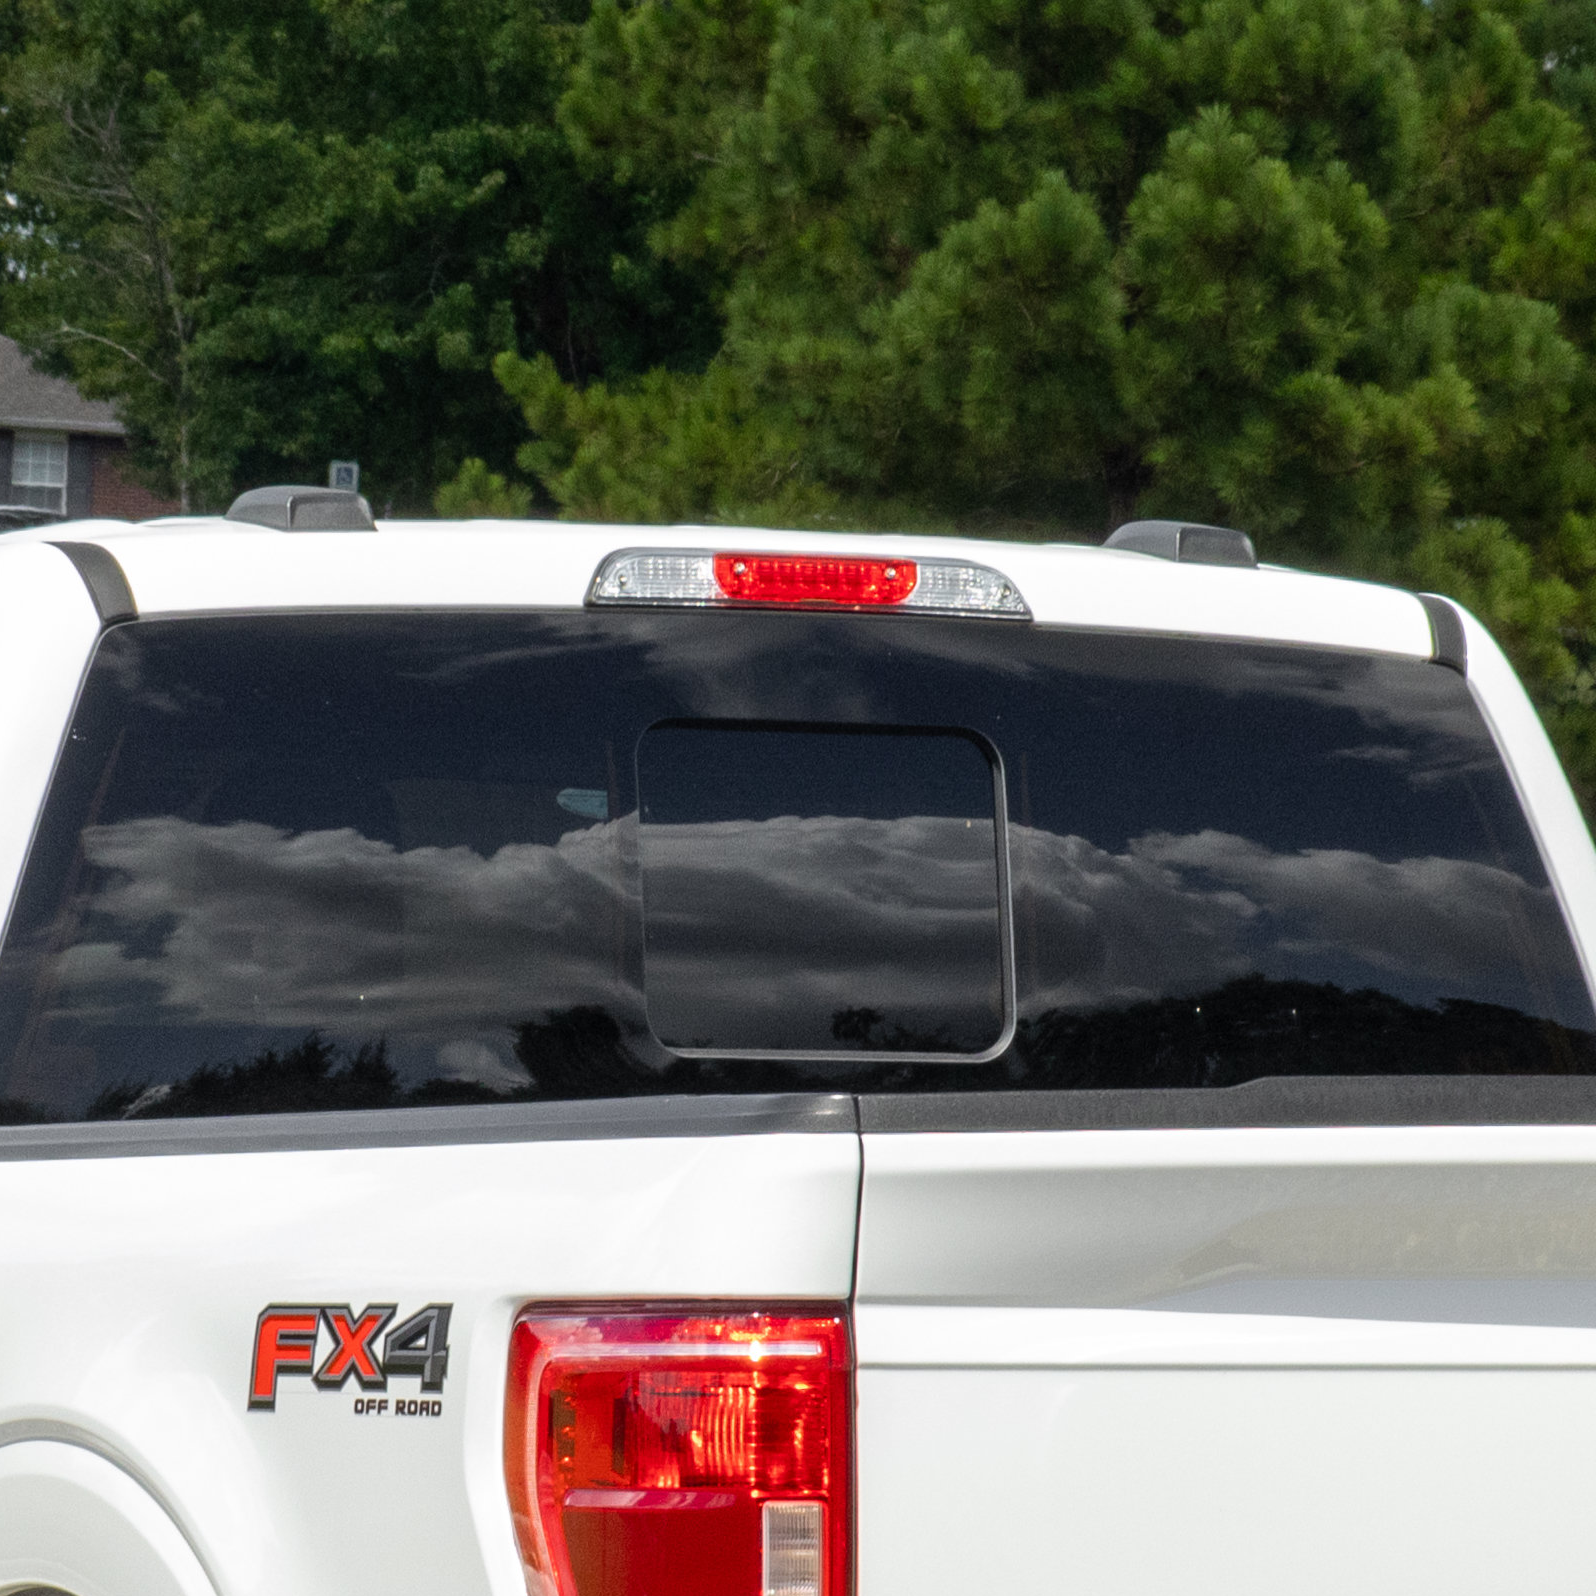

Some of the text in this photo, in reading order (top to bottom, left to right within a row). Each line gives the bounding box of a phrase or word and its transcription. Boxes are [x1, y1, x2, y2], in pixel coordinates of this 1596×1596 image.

[247, 1303, 453, 1412] FX4
[354, 1399, 442, 1417] OFF ROAD
